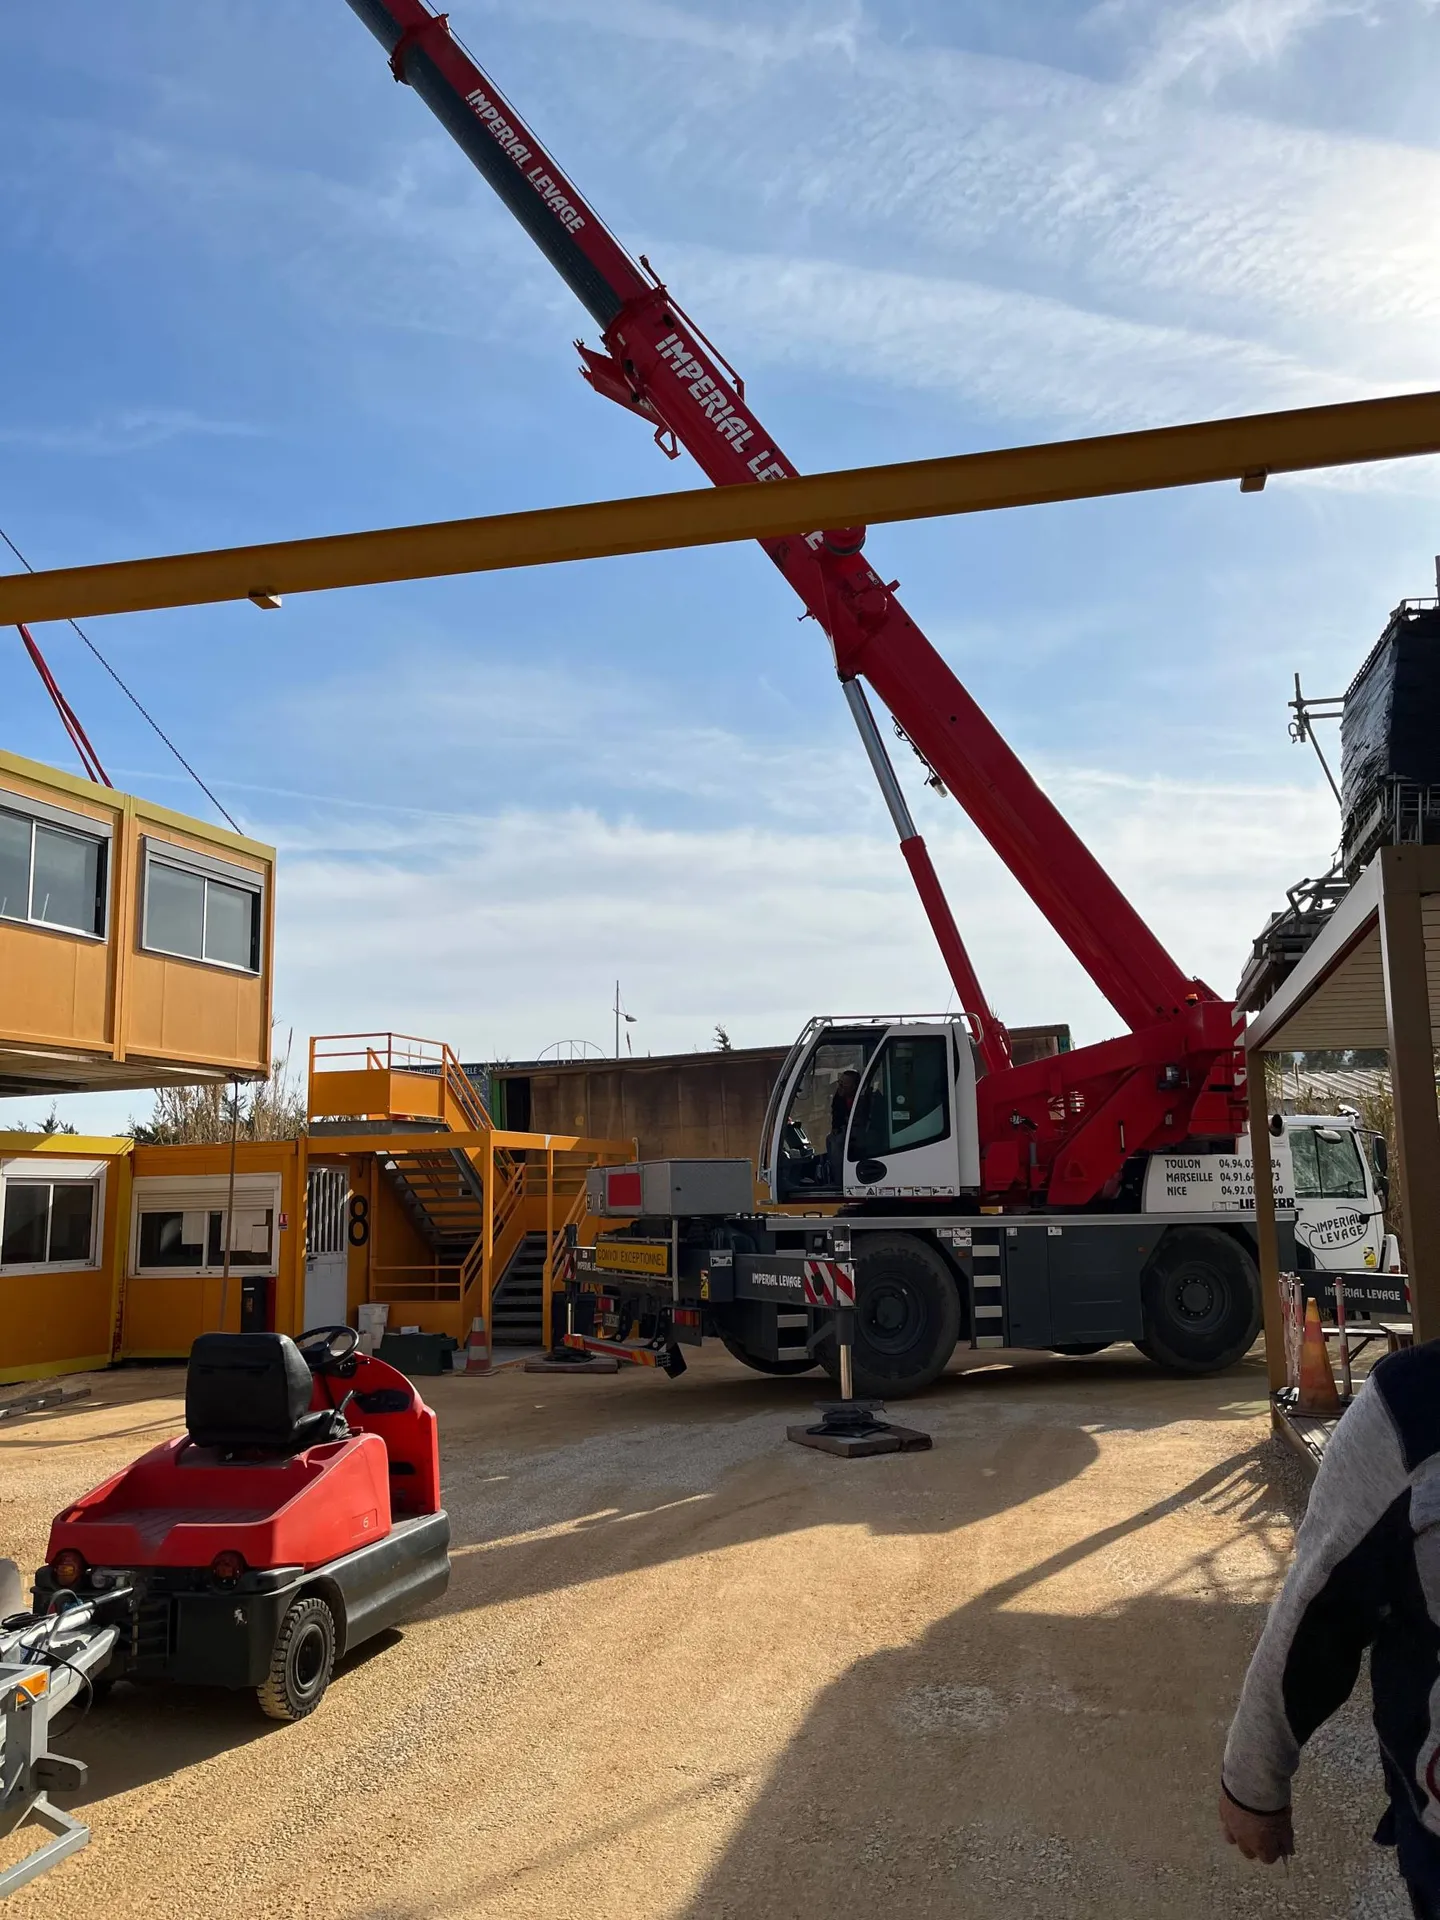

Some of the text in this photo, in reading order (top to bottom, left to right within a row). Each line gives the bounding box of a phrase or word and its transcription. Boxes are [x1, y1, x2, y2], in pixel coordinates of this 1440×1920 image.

[465, 88, 586, 234] IMPERIAL LEVAGE
[655, 333, 754, 453] IMPERIAL
[1164, 1159, 1201, 1169] TOULON
[1166, 1172, 1214, 1183] MARSEILLE
[1167, 1186, 1187, 1196] NICE
[1239, 1198, 1296, 1210] LIEERR
[348, 1195, 369, 1247] 8
[1316, 1213, 1362, 1233] IMPERIAL
[1319, 1225, 1364, 1245] LEVAGE
[751, 1272, 802, 1288] IMPERIAL LEVAGE
[1324, 1286, 1401, 1301] IMERIAL LEVAGE
